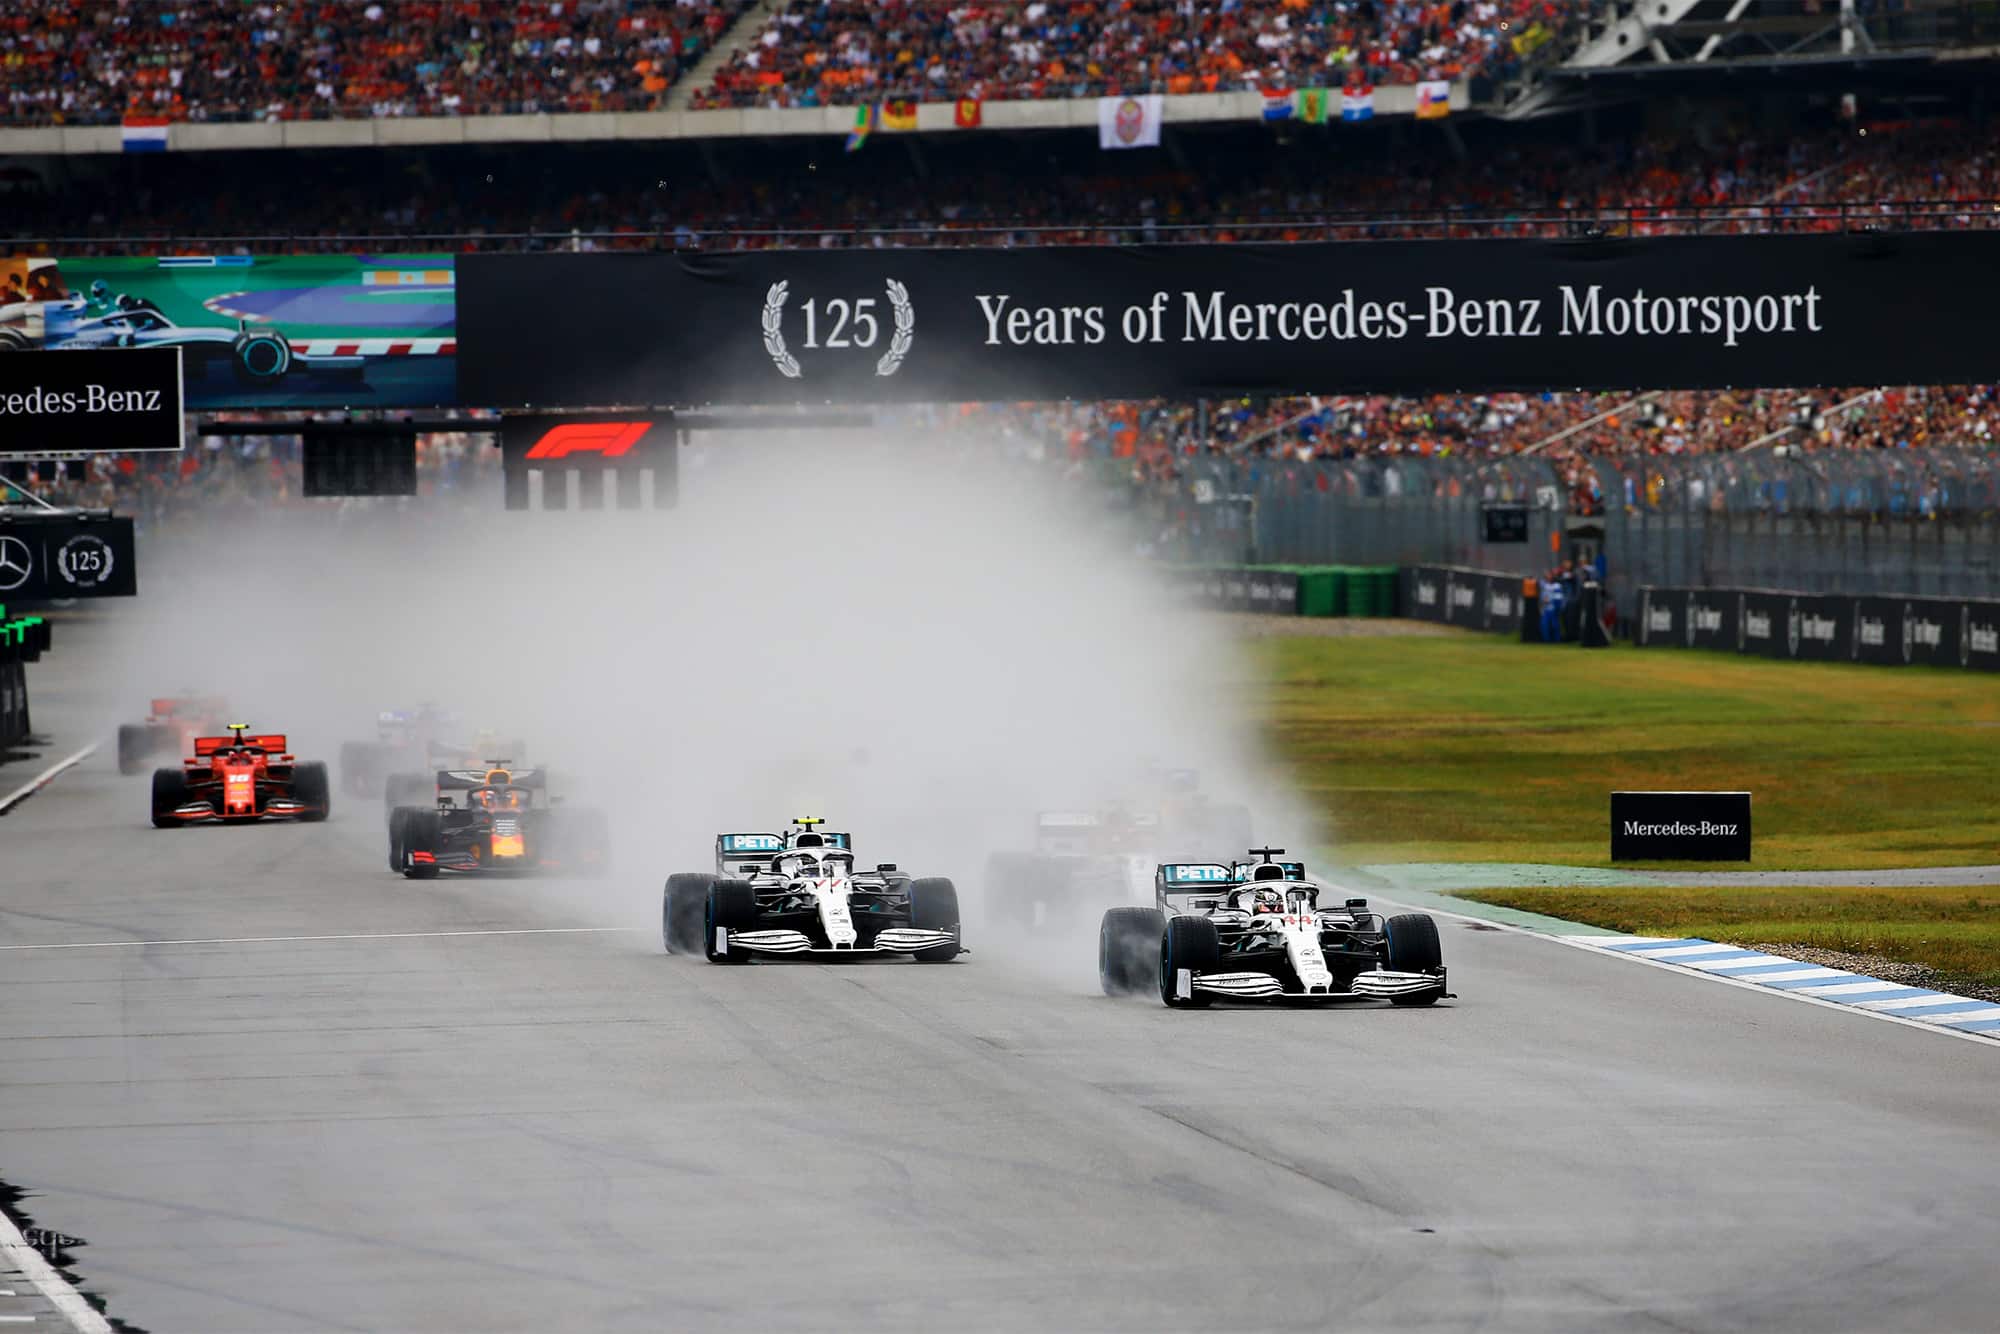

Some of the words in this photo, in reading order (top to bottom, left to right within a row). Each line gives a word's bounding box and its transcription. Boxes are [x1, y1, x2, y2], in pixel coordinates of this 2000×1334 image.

[802, 297, 879, 349] 125
[975, 294, 1105, 345] Years
[1123, 291, 1169, 343] of
[1181, 287, 1542, 342] Mercedes-Benz
[1559, 285, 1822, 347] Motorsport
[71, 551, 100, 571] 125
[1623, 820, 1738, 836] Mercedes-Benz
[734, 835, 780, 848] PETR
